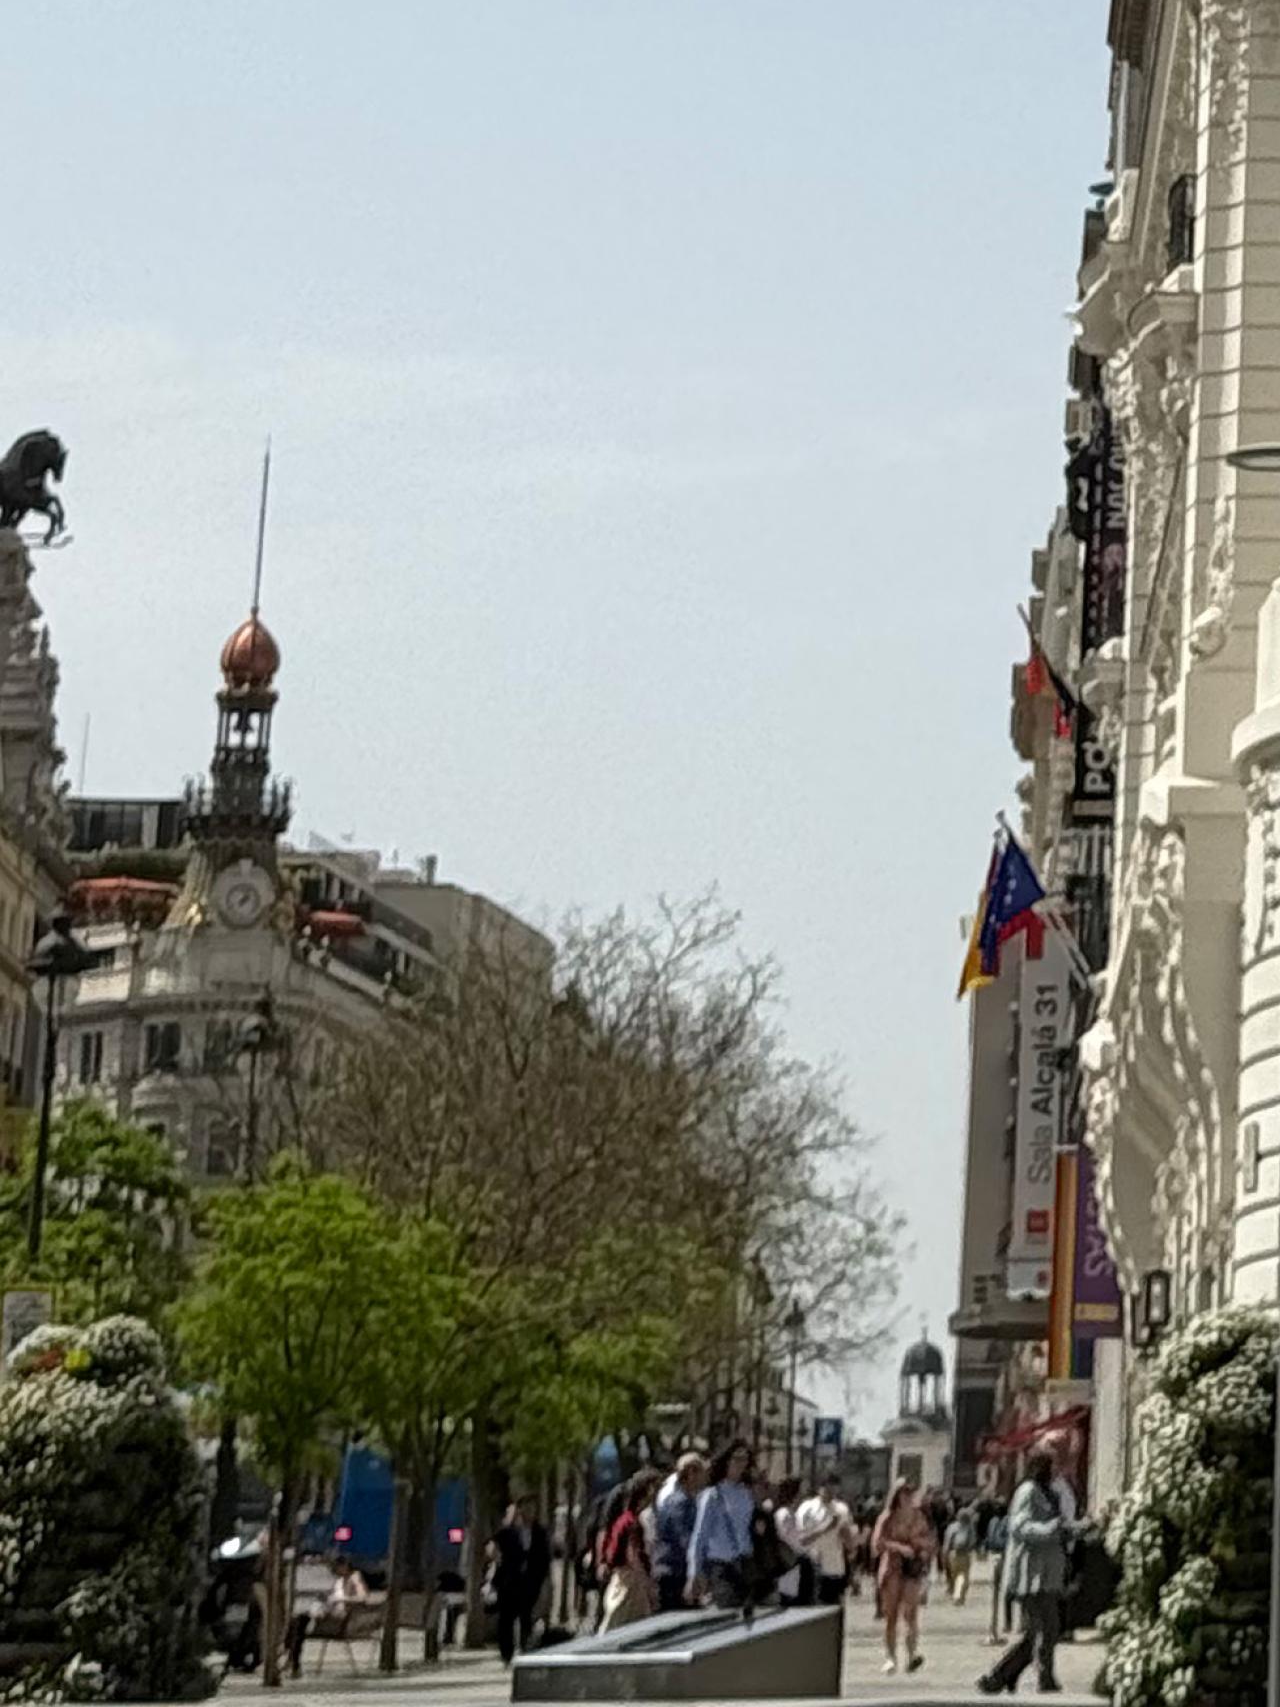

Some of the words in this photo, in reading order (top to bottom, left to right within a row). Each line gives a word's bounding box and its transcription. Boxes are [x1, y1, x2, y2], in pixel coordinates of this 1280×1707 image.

[1035, 983, 1059, 1017] 31
[1030, 1025, 1059, 1116] Alcalá
[1027, 1124, 1051, 1184] Sala
